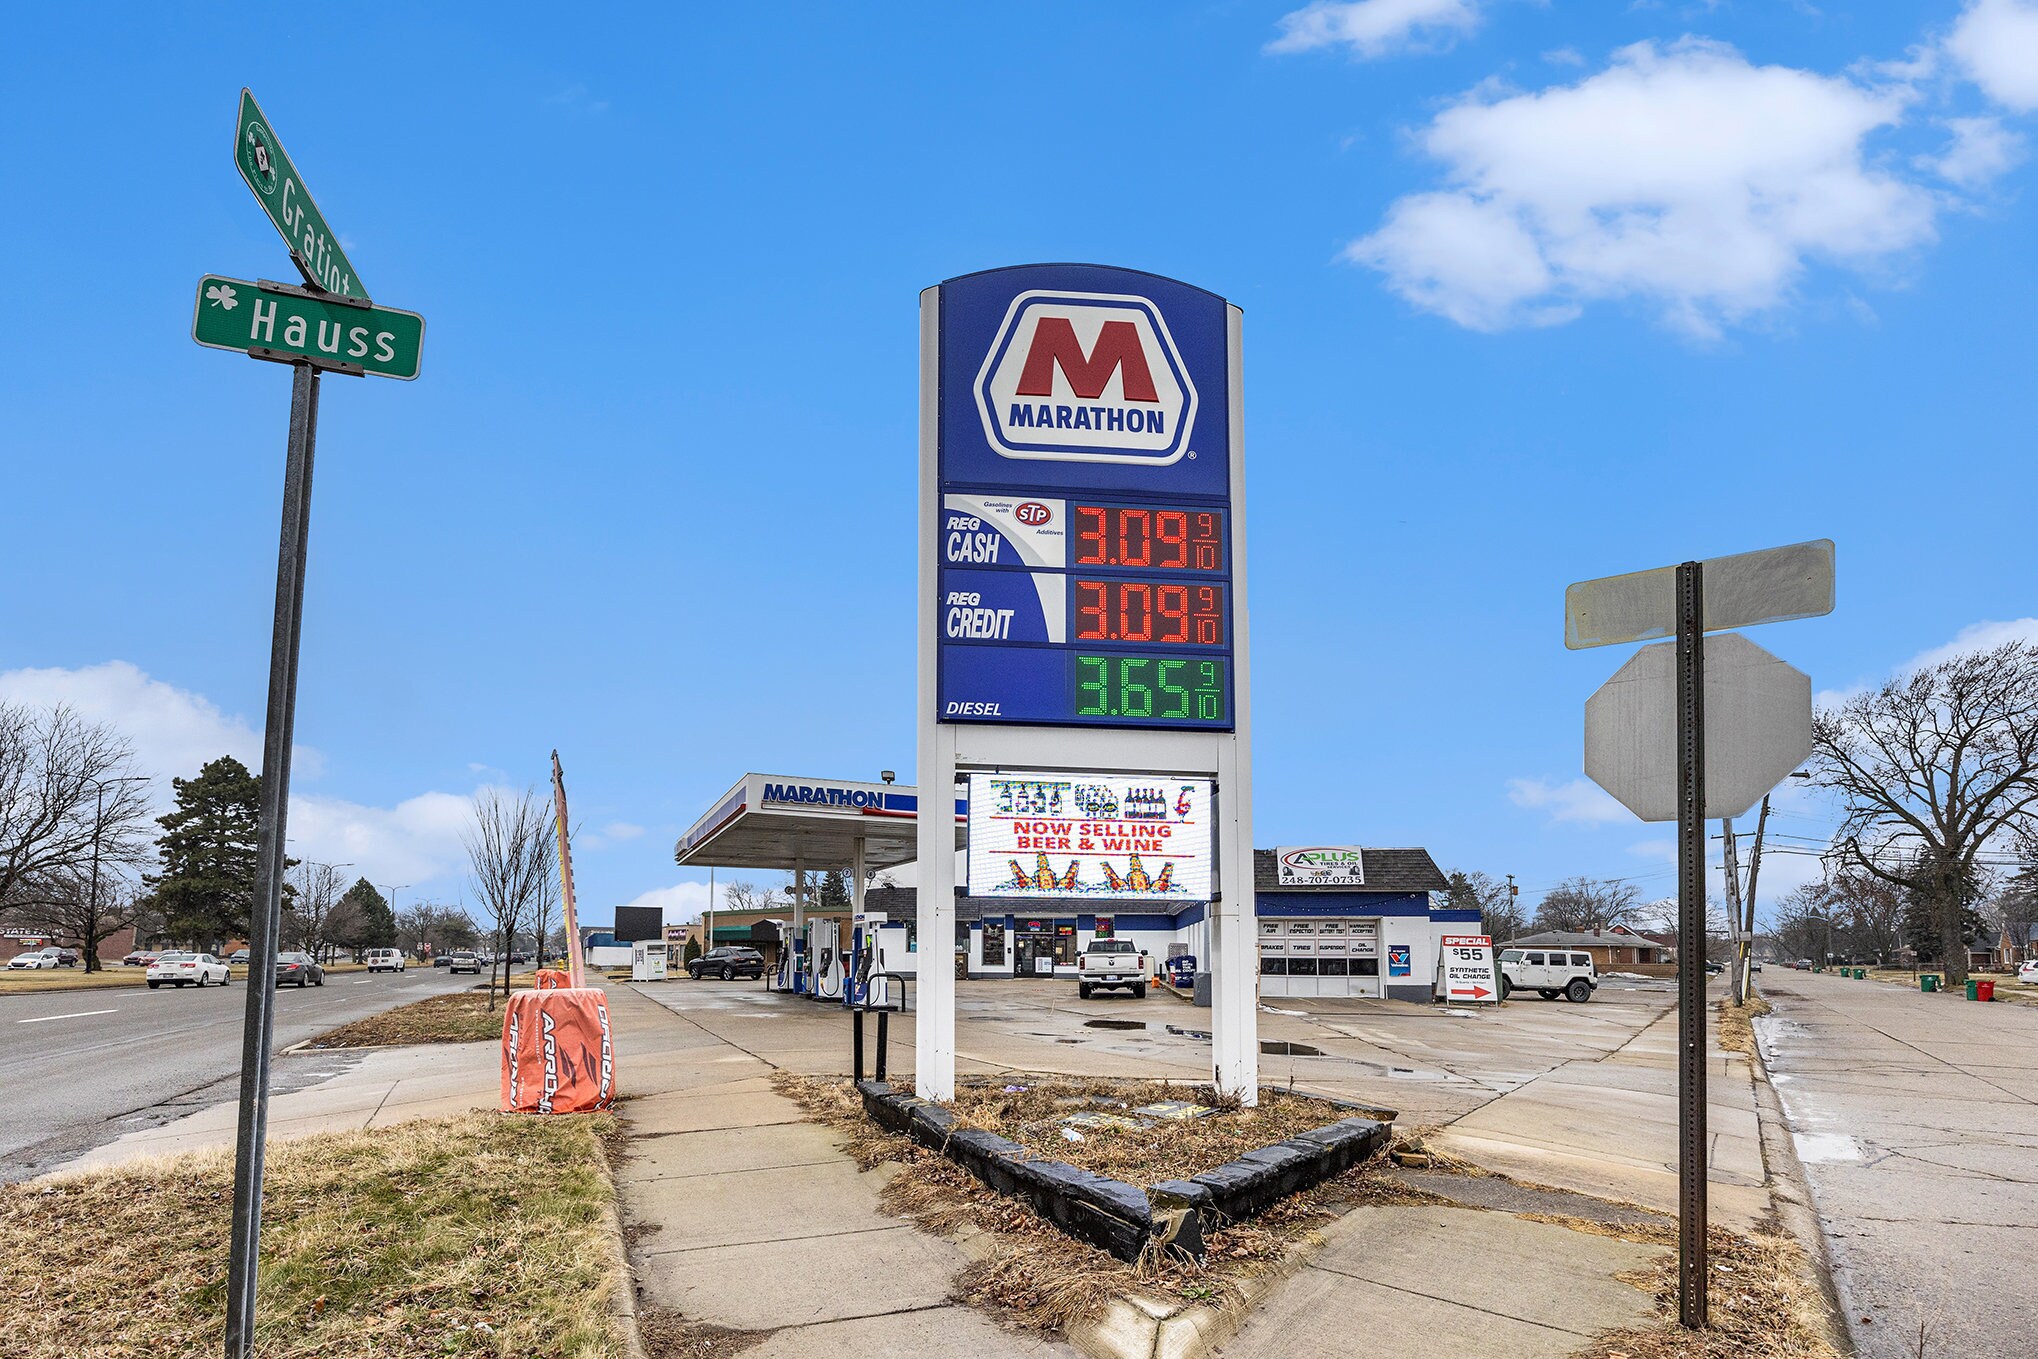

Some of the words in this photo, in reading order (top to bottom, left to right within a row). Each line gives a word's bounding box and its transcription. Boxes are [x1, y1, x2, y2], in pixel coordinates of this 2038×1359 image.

[283, 178, 350, 295] Gratiot
[250, 298, 395, 363] Hauss
[1015, 316, 1160, 403] M
[1008, 404, 1164, 434] MARATHON
[983, 501, 1013, 509] Gasolines
[1019, 505, 1047, 523] STP
[946, 516, 981, 531] REG
[1036, 528, 1064, 536] Additives
[1078, 507, 1187, 569] 3.09
[947, 532, 1001, 564] CASH
[946, 592, 981, 606] REG
[1078, 581, 1188, 643] 3.09
[947, 608, 1015, 640] CREDIT
[1078, 656, 1189, 718] 3.65
[946, 701, 1002, 716] DIESEL
[762, 783, 884, 809] MARATHON
[1013, 821, 1072, 836] NOW
[1079, 823, 1172, 838] SELLING
[1017, 836, 1071, 849] BEER
[1078, 837, 1095, 850] &
[1102, 838, 1163, 852] WINE
[1281, 876, 1362, 884] 248-707-0735
[1444, 936, 1490, 946] SPECIAL
[1452, 948, 1483, 961] $55
